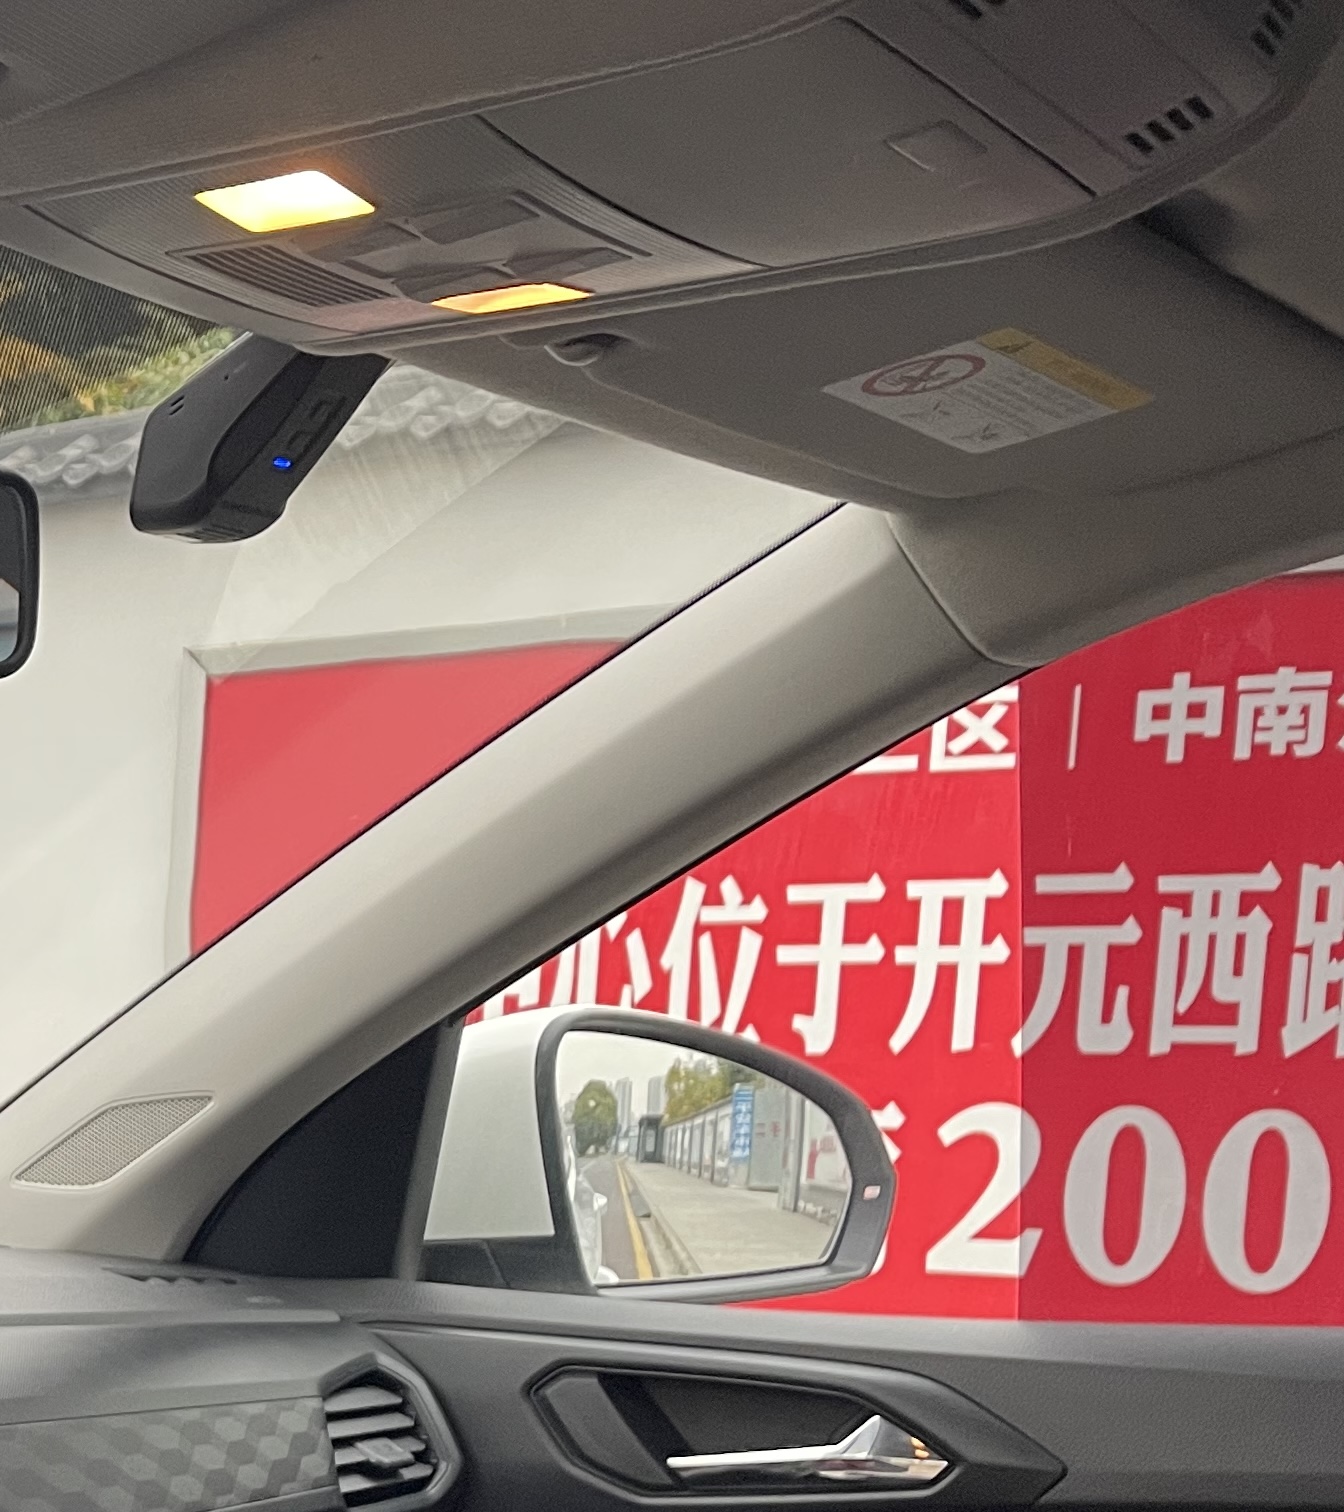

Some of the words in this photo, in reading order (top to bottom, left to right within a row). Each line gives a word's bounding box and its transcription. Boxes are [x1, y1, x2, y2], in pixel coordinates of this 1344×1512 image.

[853, 684, 1019, 774] 区
[1133, 666, 1344, 764] 中南
[477, 861, 1344, 1058] 心位于开元西路
[865, 1100, 1331, 1295] 200
